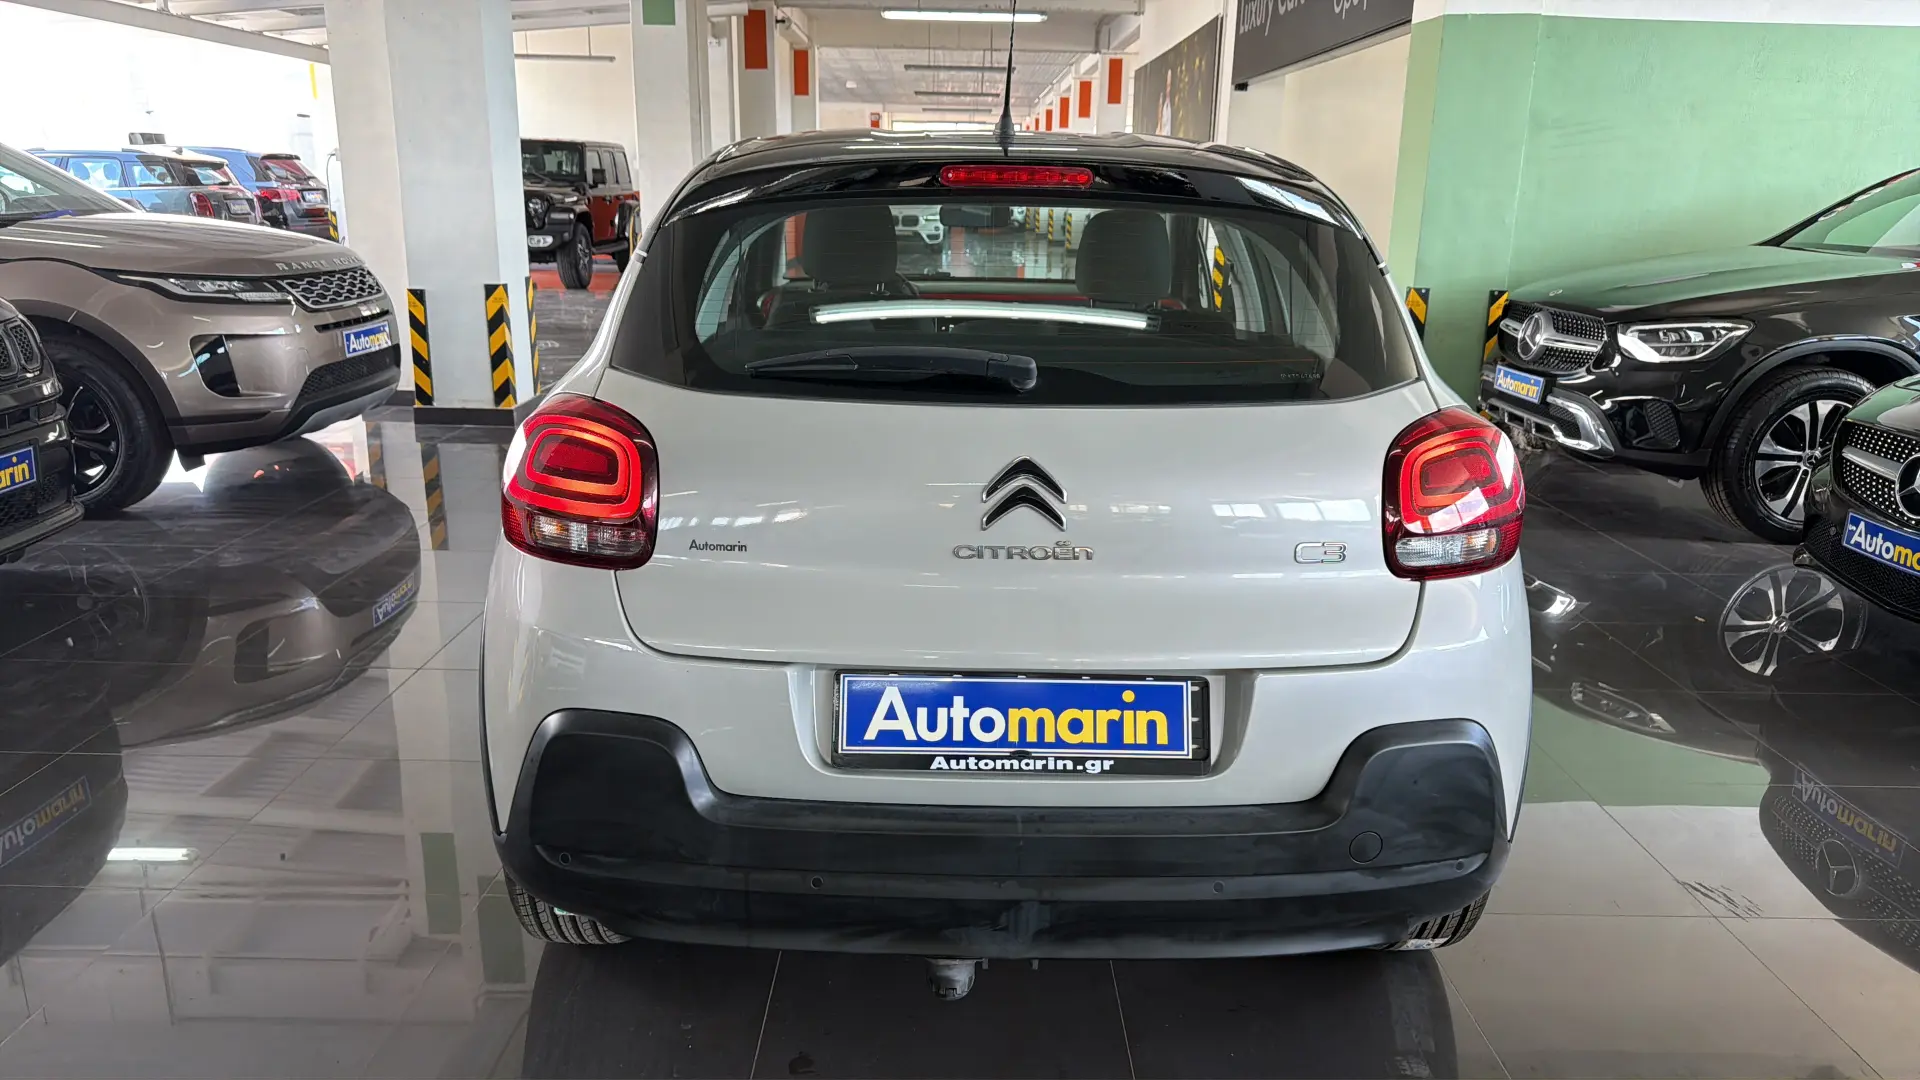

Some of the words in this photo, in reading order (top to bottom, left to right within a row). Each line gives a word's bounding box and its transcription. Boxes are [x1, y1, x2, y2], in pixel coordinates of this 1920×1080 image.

[275, 261, 328, 271] RANGE
[332, 256, 360, 267] ROVE
[1497, 369, 1539, 398] Automarin
[689, 539, 747, 552] Automarin
[1294, 541, 1348, 564] C3
[863, 686, 1169, 745] Automarin
[930, 756, 1114, 774] Automarin.gr
